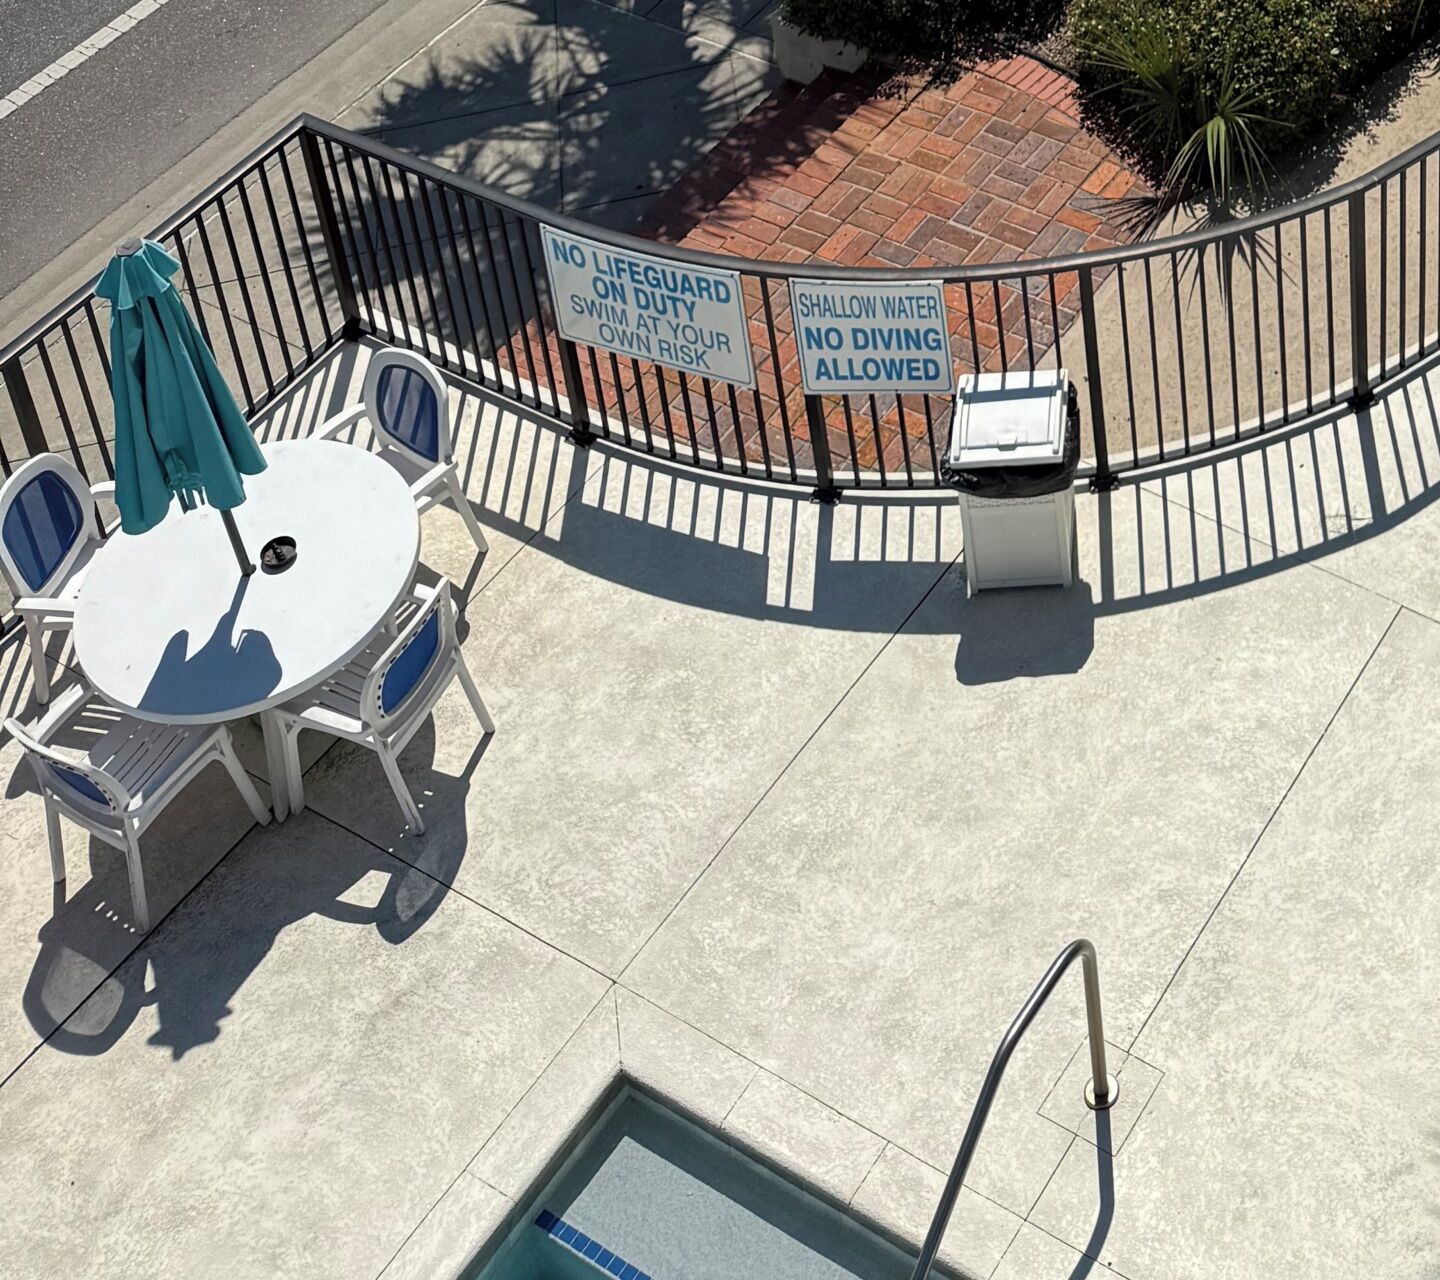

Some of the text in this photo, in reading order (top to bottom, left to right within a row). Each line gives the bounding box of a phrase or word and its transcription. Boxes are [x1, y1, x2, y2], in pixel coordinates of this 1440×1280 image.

[552, 238, 731, 304] NO LIFEGUARD
[592, 276, 696, 322] ON DUTY
[799, 293, 939, 320] SHALLOW WATER
[570, 294, 731, 354] SWIM AT YOUR
[599, 323, 710, 369] OWN RISK
[805, 327, 942, 351] NO DIVING
[815, 357, 940, 381] ALLOWED
